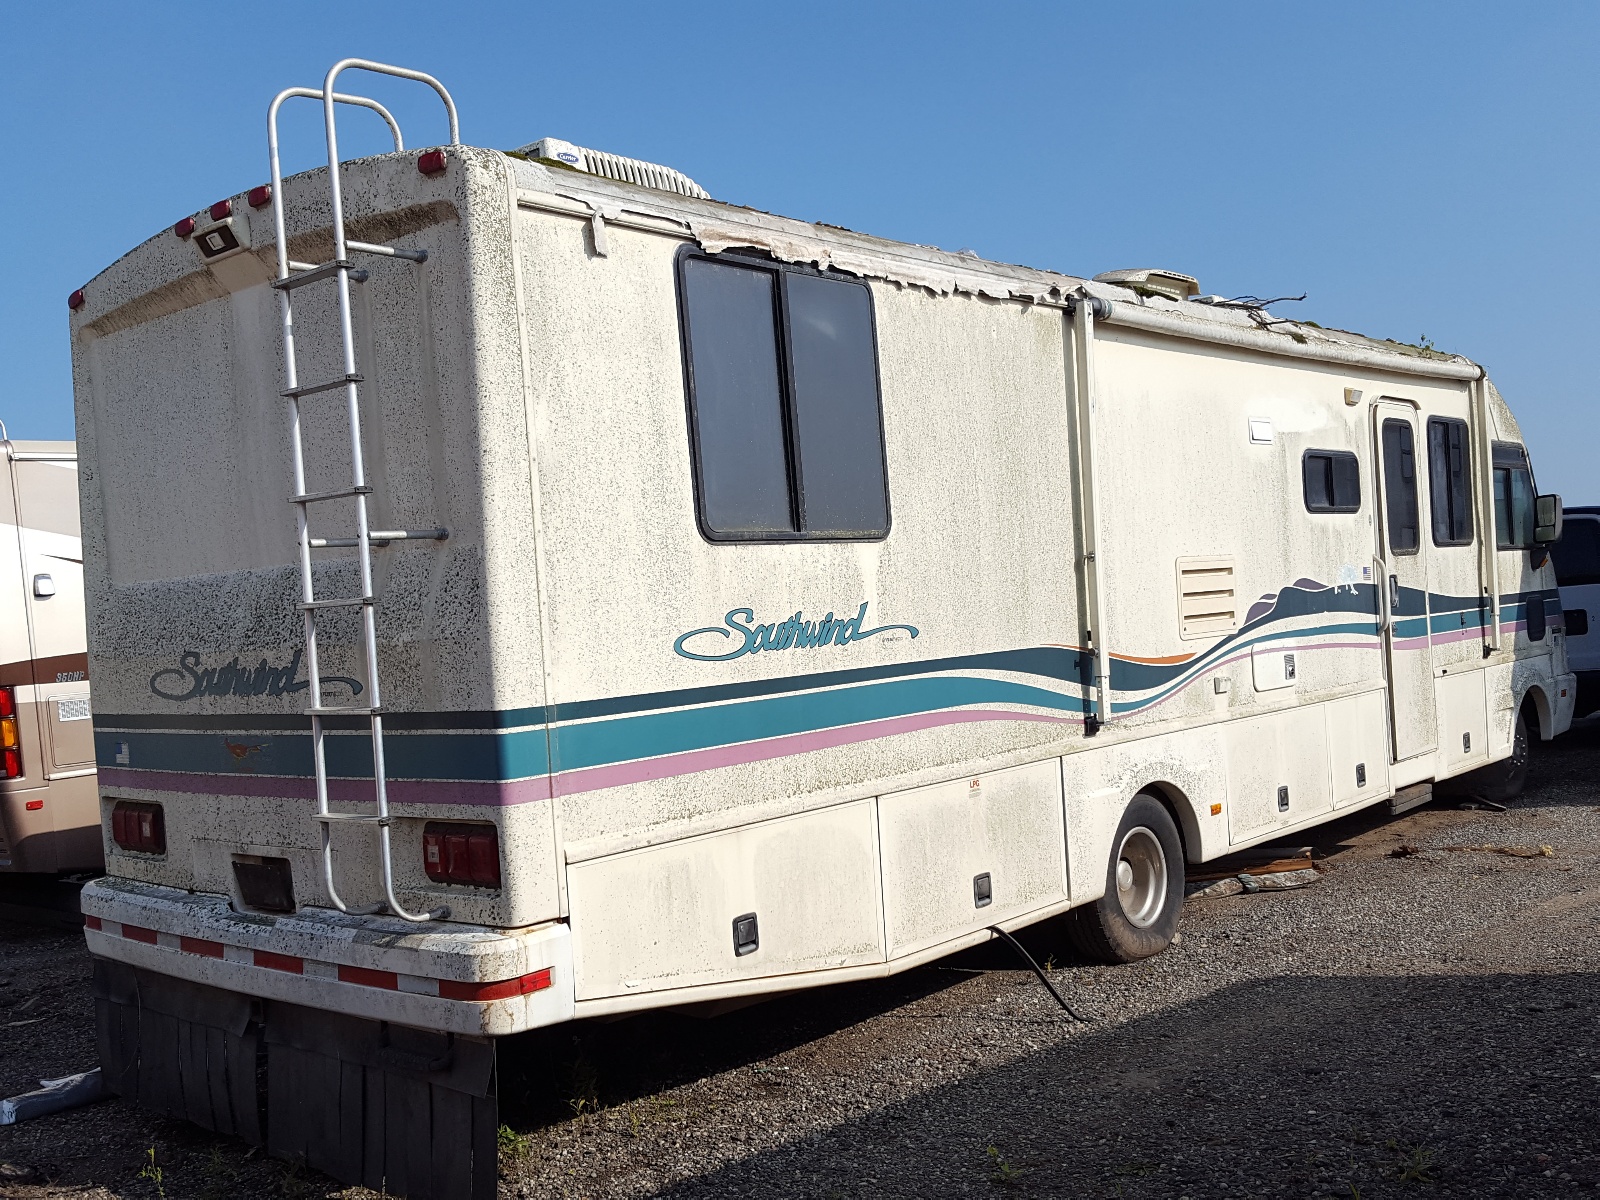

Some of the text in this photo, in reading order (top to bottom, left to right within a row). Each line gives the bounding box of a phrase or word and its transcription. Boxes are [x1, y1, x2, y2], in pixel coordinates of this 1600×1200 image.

[559, 153, 577, 162] Carrier
[673, 601, 920, 662] Southwind
[150, 648, 363, 701] Southwind
[969, 779, 980, 789] LPG
